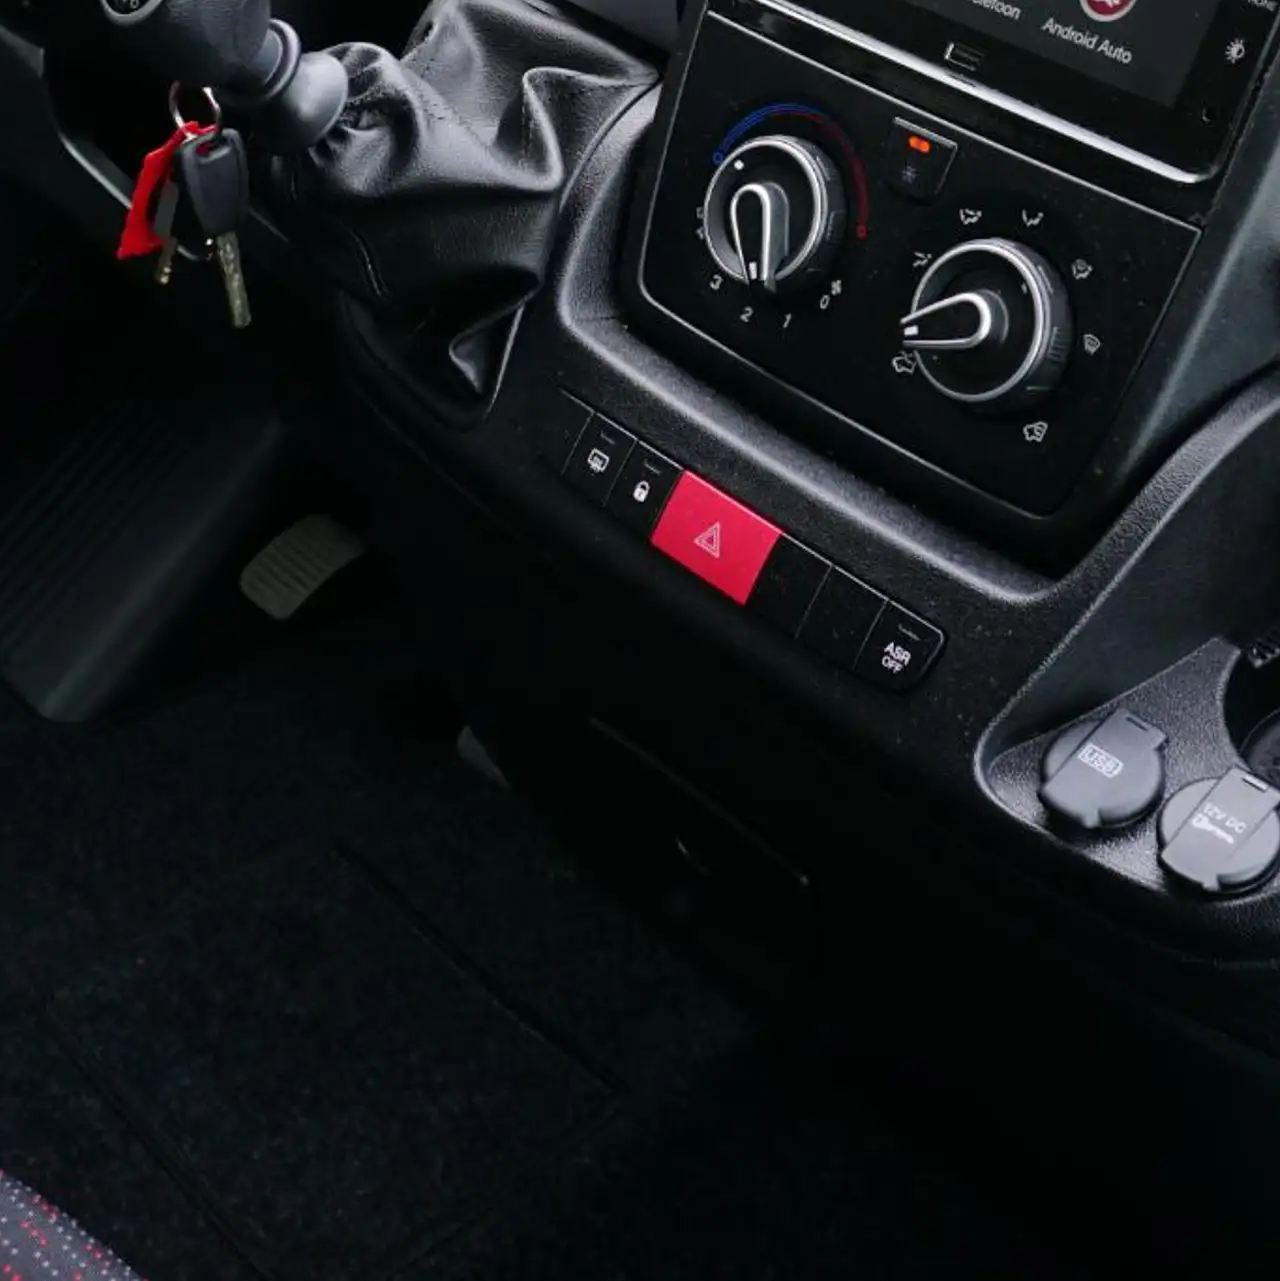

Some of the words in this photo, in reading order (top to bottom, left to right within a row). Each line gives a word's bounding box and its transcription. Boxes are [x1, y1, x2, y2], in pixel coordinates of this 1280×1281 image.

[1041, 17, 1099, 50] Android
[1097, 38, 1133, 65] Auto
[709, 274, 723, 291] 3
[819, 294, 831, 310] 0
[739, 306, 754, 323] 2
[783, 312, 792, 329] 1
[881, 654, 904, 675] OFF
[883, 641, 912, 667] ASR
[1081, 746, 1121, 776] USB
[1203, 802, 1227, 822] 12V
[1225, 817, 1248, 835] DC
